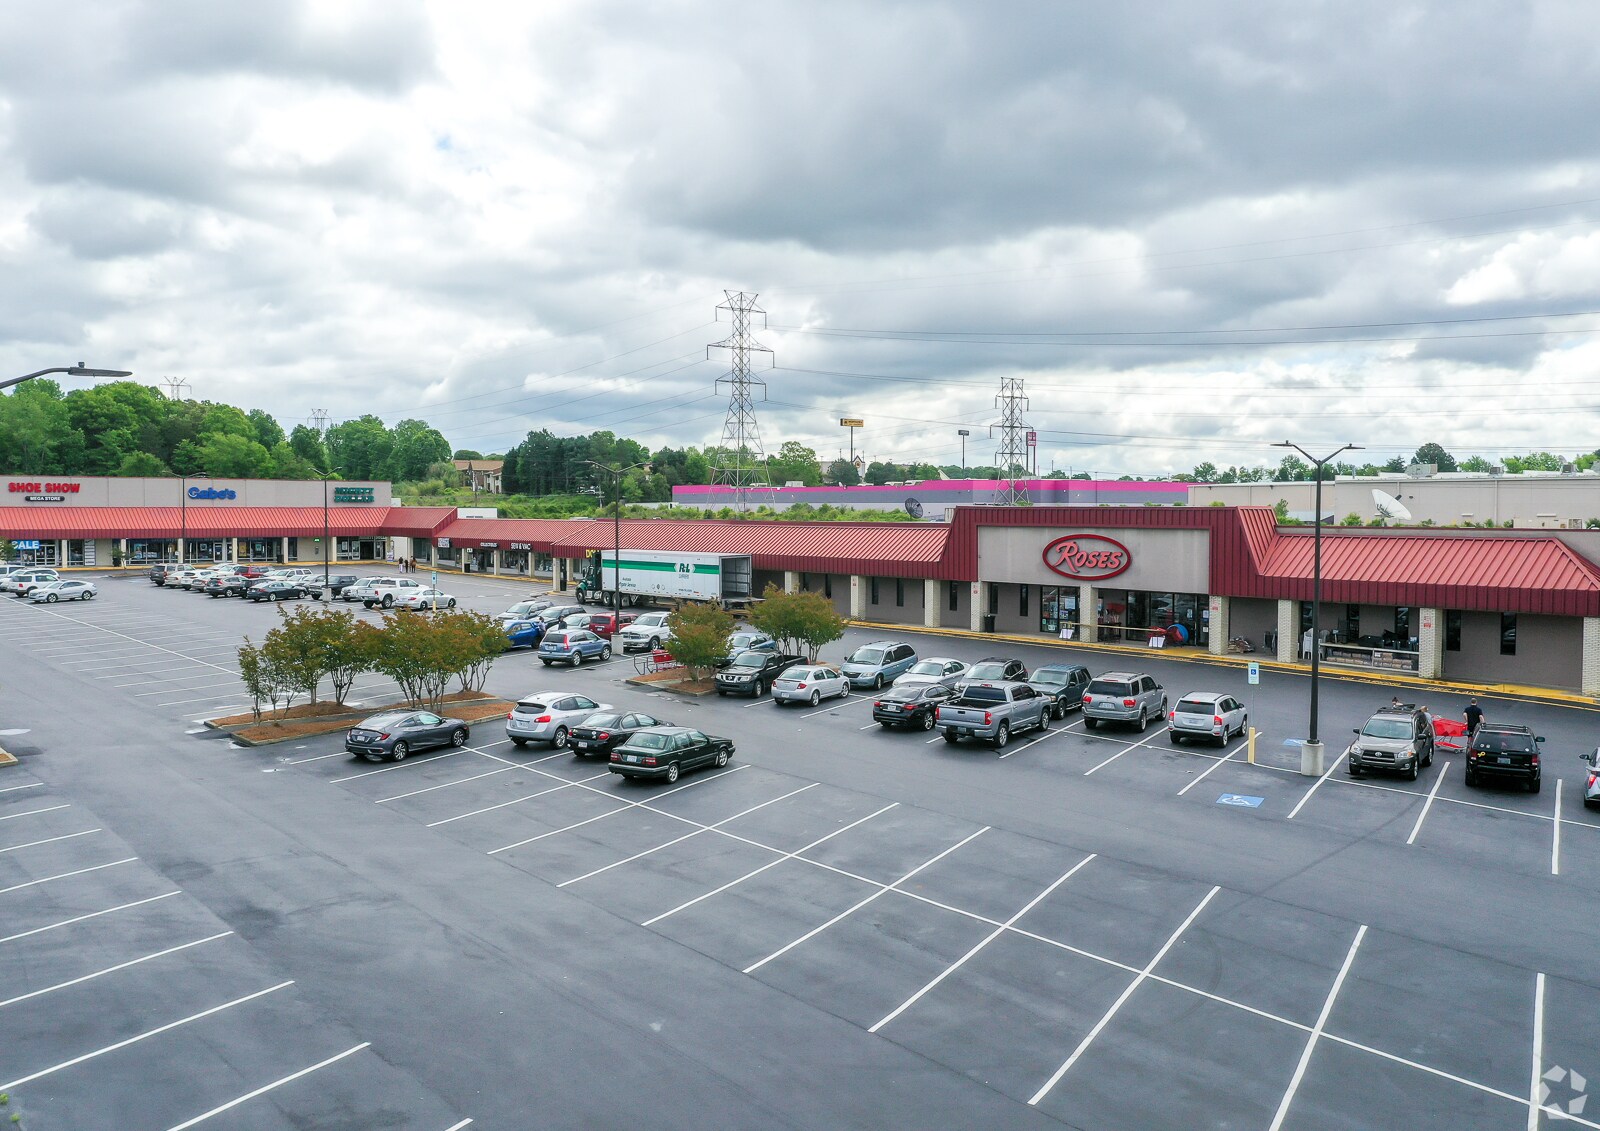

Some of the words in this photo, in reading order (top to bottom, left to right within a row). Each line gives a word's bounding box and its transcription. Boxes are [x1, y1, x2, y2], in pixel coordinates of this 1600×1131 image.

[8, 482, 41, 493] SHOE
[45, 483, 80, 493] SHOW
[188, 486, 237, 500] Gabe's
[334, 495, 374, 503] DOLLAR
